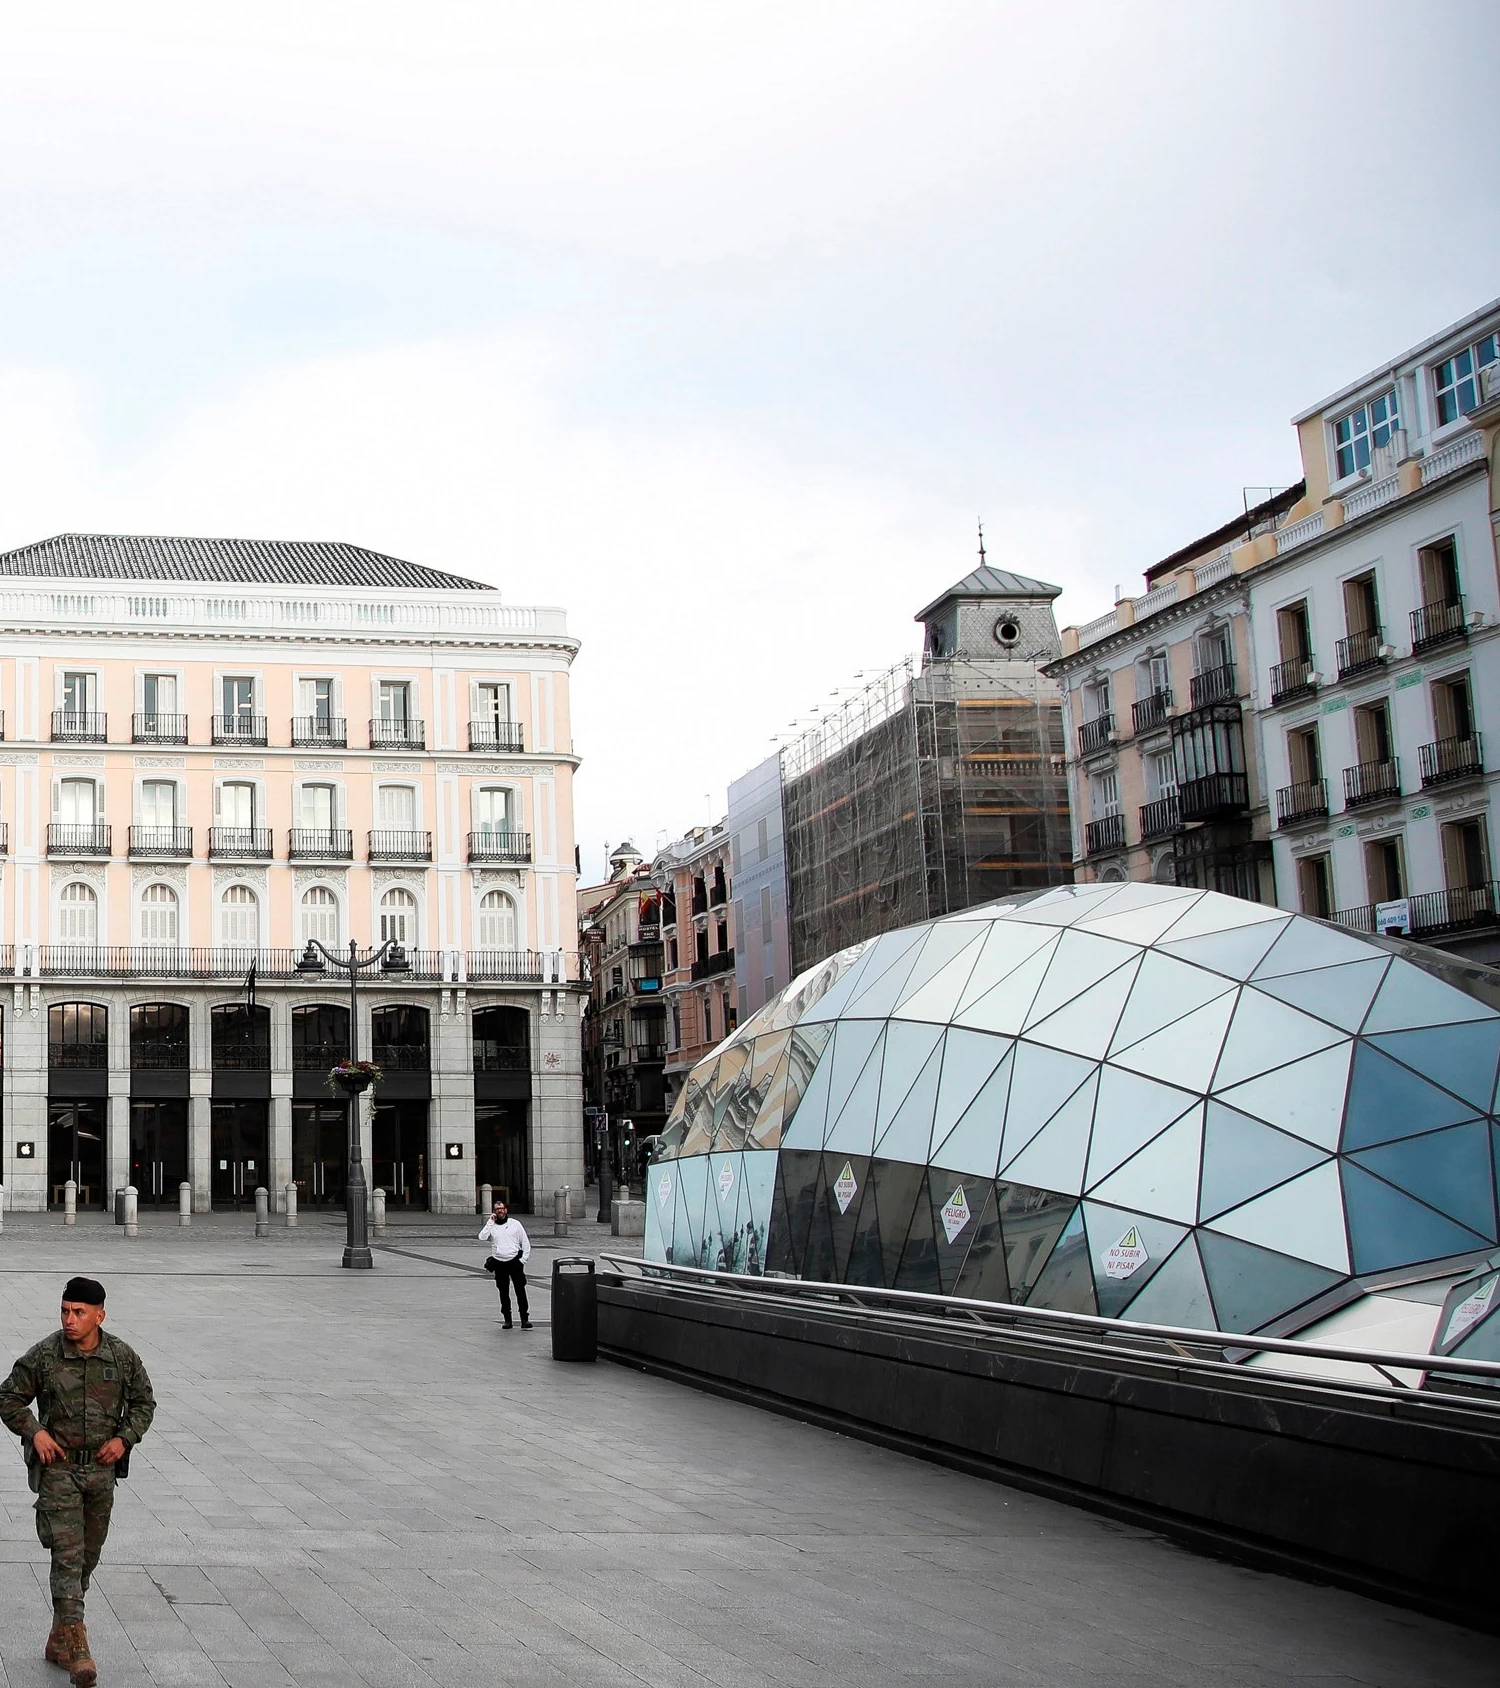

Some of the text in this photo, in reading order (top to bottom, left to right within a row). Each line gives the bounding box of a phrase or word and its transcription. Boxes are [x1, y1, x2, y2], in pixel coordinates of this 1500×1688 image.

[945, 1208, 966, 1219] PELIGRO
[1110, 1249, 1140, 1258] NO SUBIR
[1116, 1262, 1135, 1270] PISAR
